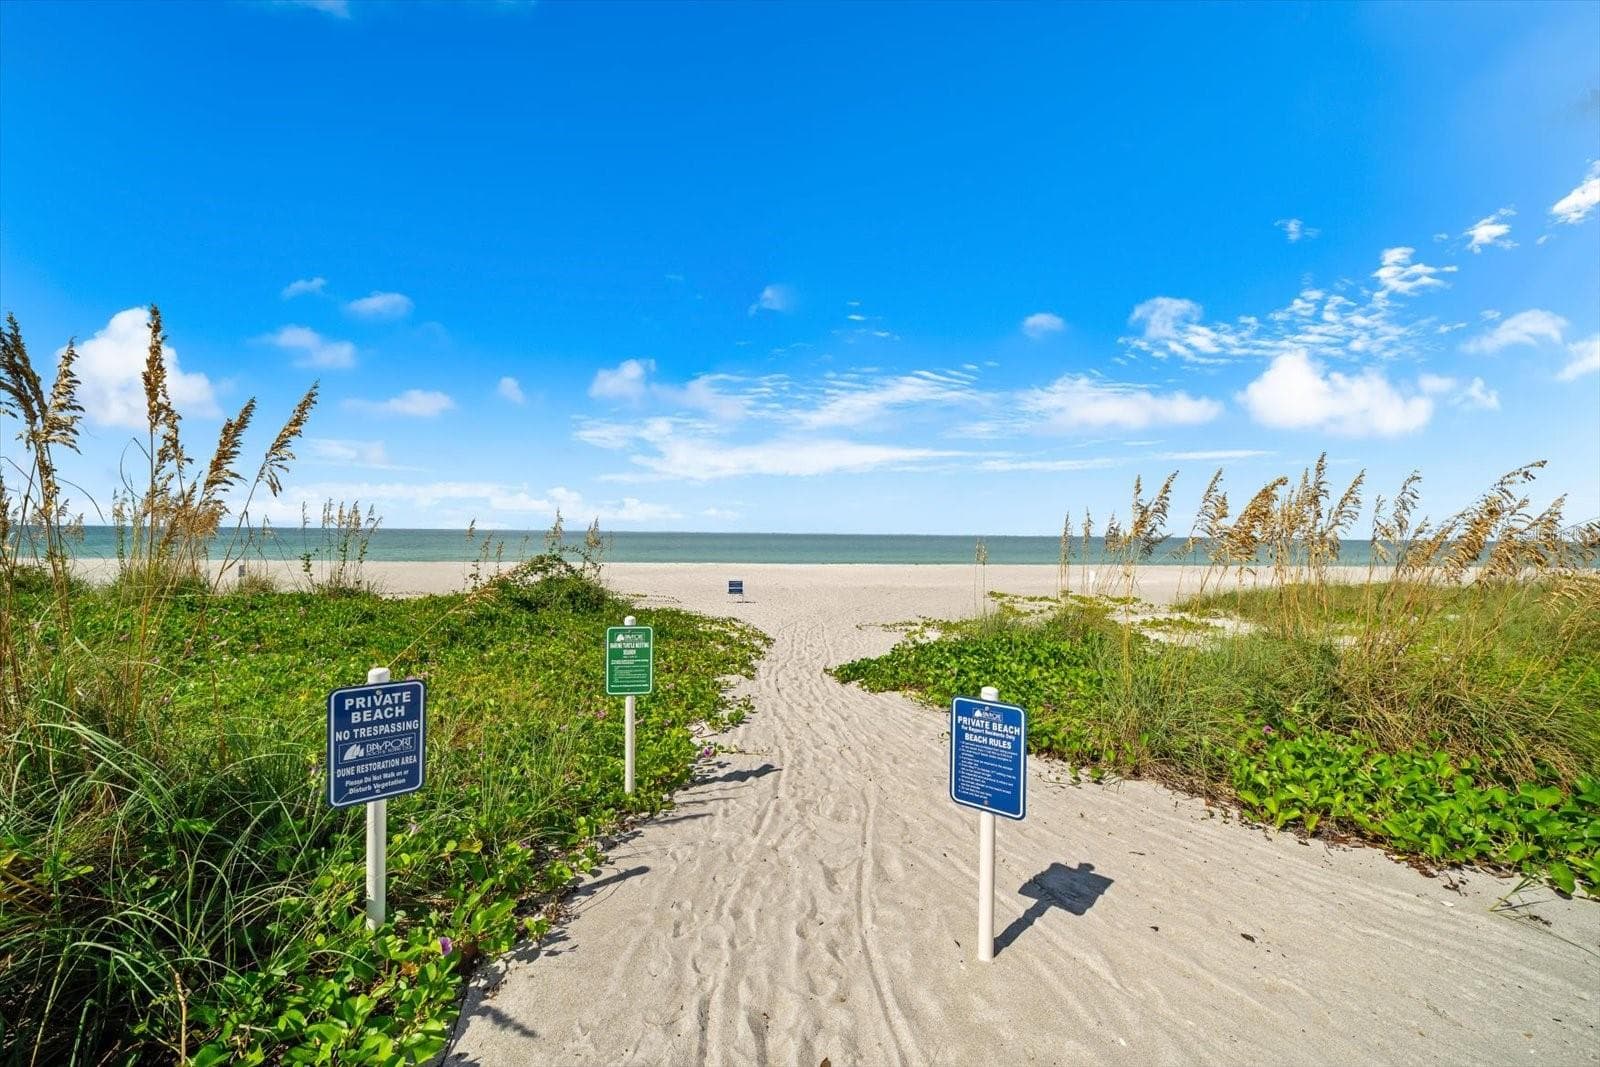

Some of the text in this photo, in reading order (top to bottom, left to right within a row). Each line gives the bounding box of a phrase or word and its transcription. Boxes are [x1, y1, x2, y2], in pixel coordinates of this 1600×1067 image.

[344, 692, 411, 710] PRIVATE
[351, 706, 405, 723] BEACH
[336, 720, 419, 742] NO TRESPASSING
[958, 716, 1020, 736] PRIVATE BEACH
[366, 737, 412, 752] BAYPORT
[965, 733, 1012, 749] BEACH RULES
[336, 755, 417, 778] DUNE RESTORATION AREA
[345, 779, 363, 787] Please
[349, 778, 406, 794] Disturb Vegetation
